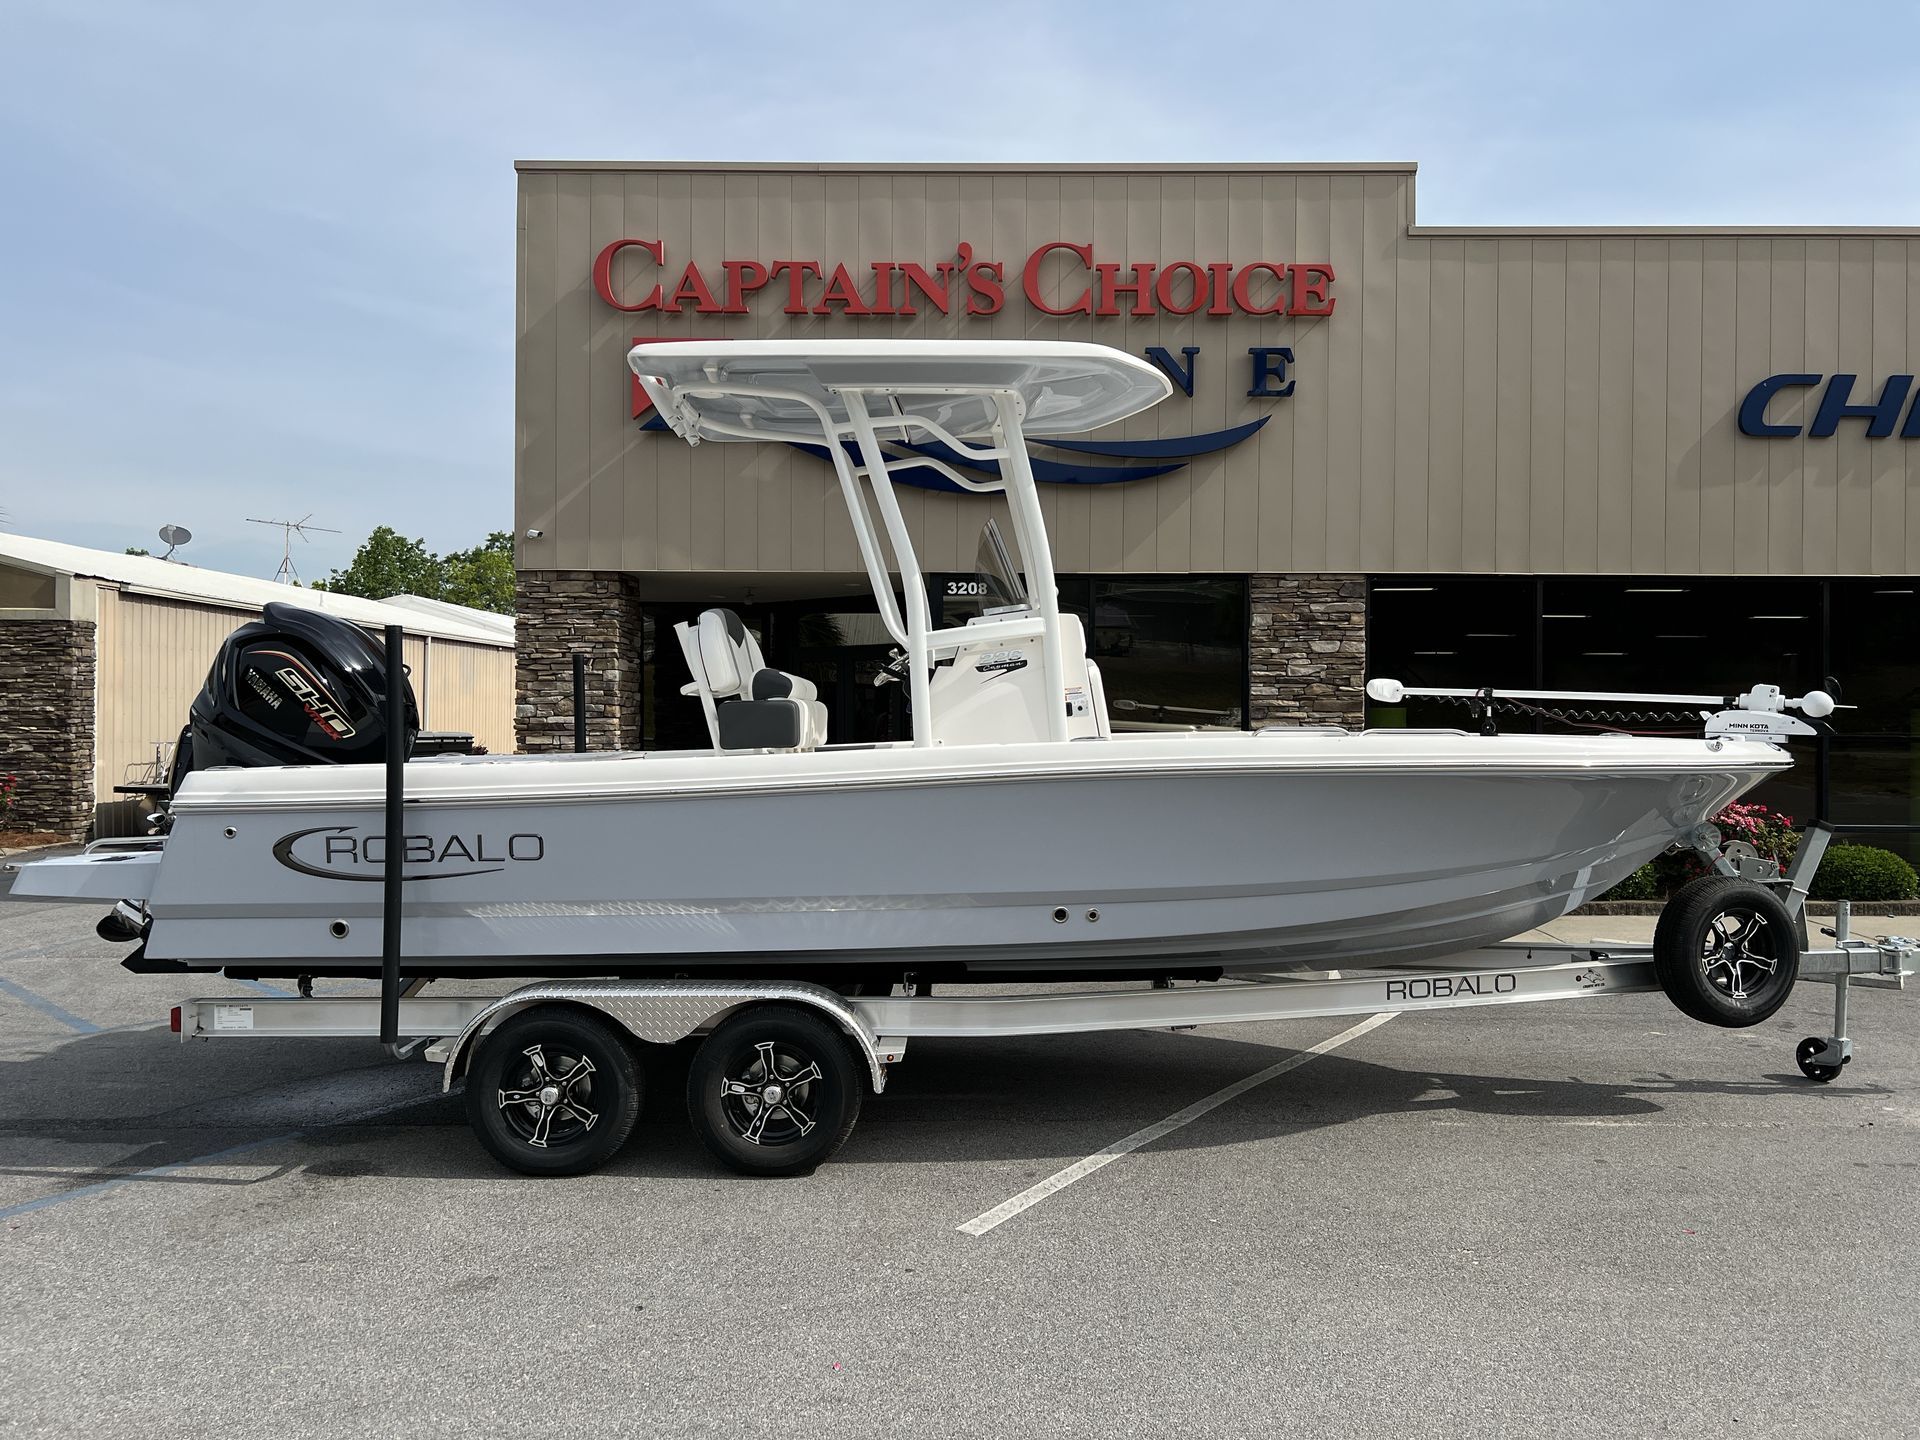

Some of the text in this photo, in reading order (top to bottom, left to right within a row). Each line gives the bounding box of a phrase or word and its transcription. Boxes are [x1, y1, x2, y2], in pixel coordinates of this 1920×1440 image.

[593, 238, 1337, 318] CAPTAIN'S CHOICE
[1737, 373, 1920, 438] CH
[947, 581, 988, 595] 3208
[244, 667, 283, 711] YAMAHA
[275, 667, 356, 739] SHO
[325, 833, 545, 864] ROBALO
[1386, 973, 1516, 1000] ROBALO
